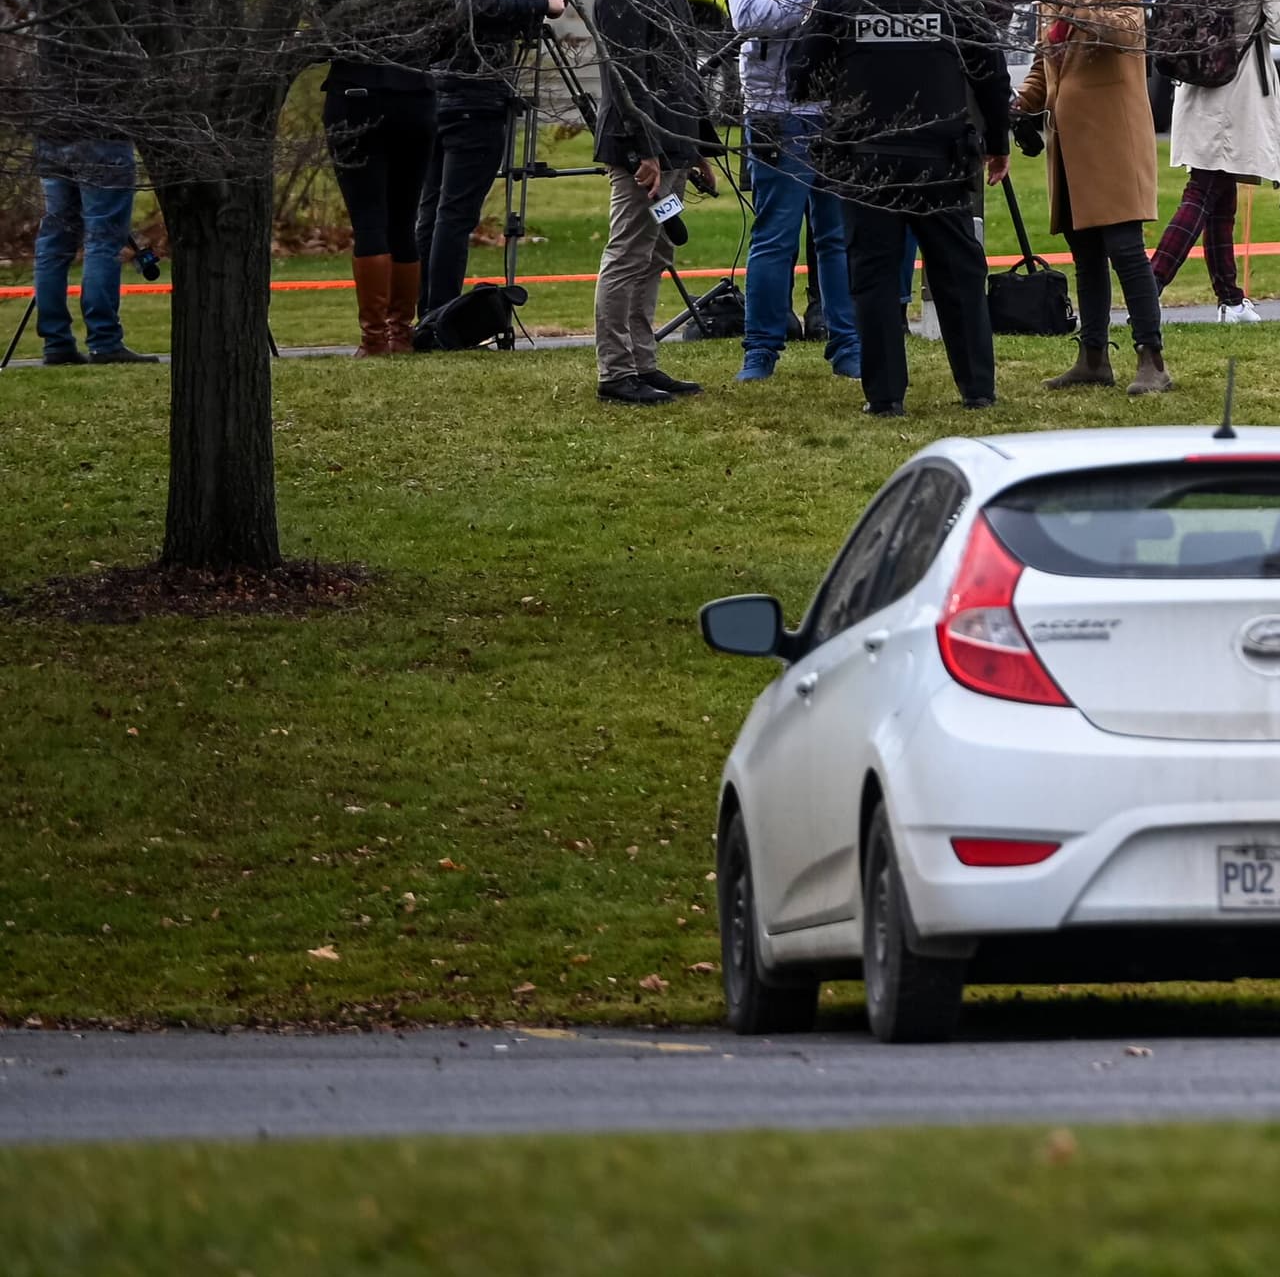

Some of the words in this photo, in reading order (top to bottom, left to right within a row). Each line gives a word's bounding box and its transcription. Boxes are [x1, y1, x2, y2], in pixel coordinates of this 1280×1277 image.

[857, 17, 938, 38] POLICE
[655, 198, 679, 218] LCN
[1224, 862, 1275, 894] P02
